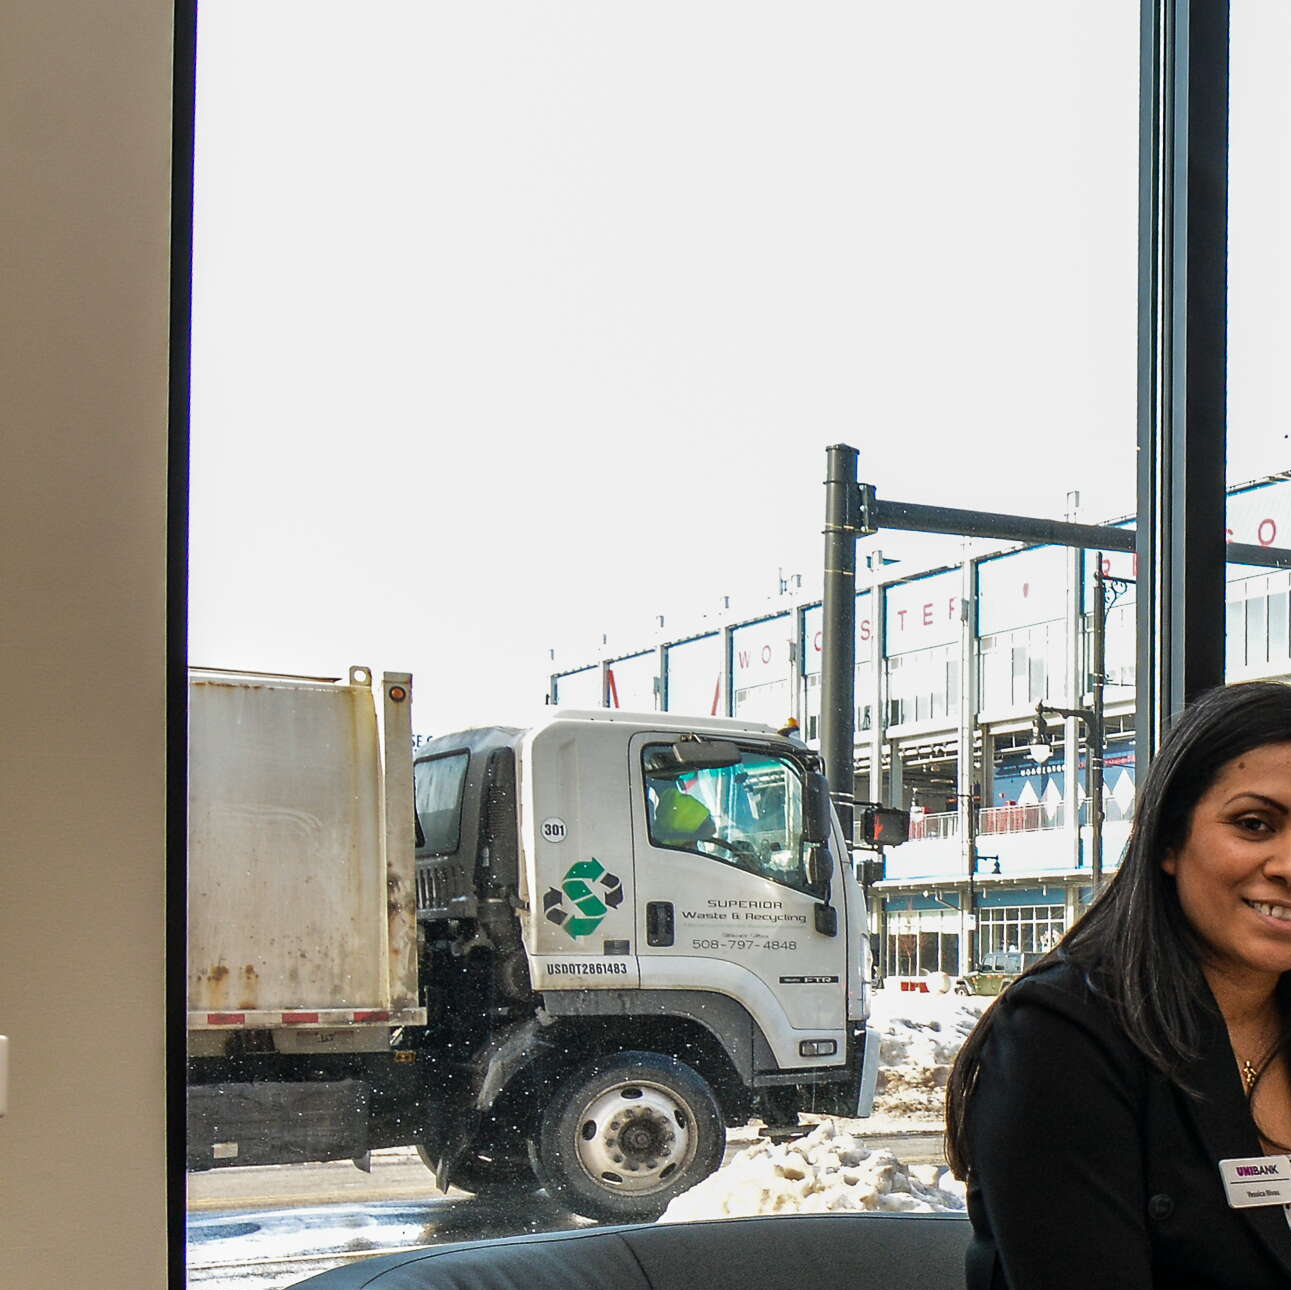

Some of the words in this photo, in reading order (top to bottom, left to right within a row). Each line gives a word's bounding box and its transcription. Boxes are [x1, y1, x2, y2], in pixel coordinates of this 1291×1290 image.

[544, 824, 565, 837] 301
[706, 899, 783, 910] SUPERIOR
[682, 911, 728, 921] Waste
[744, 911, 808, 924] Recycling
[691, 938, 798, 952] 508-797-4848
